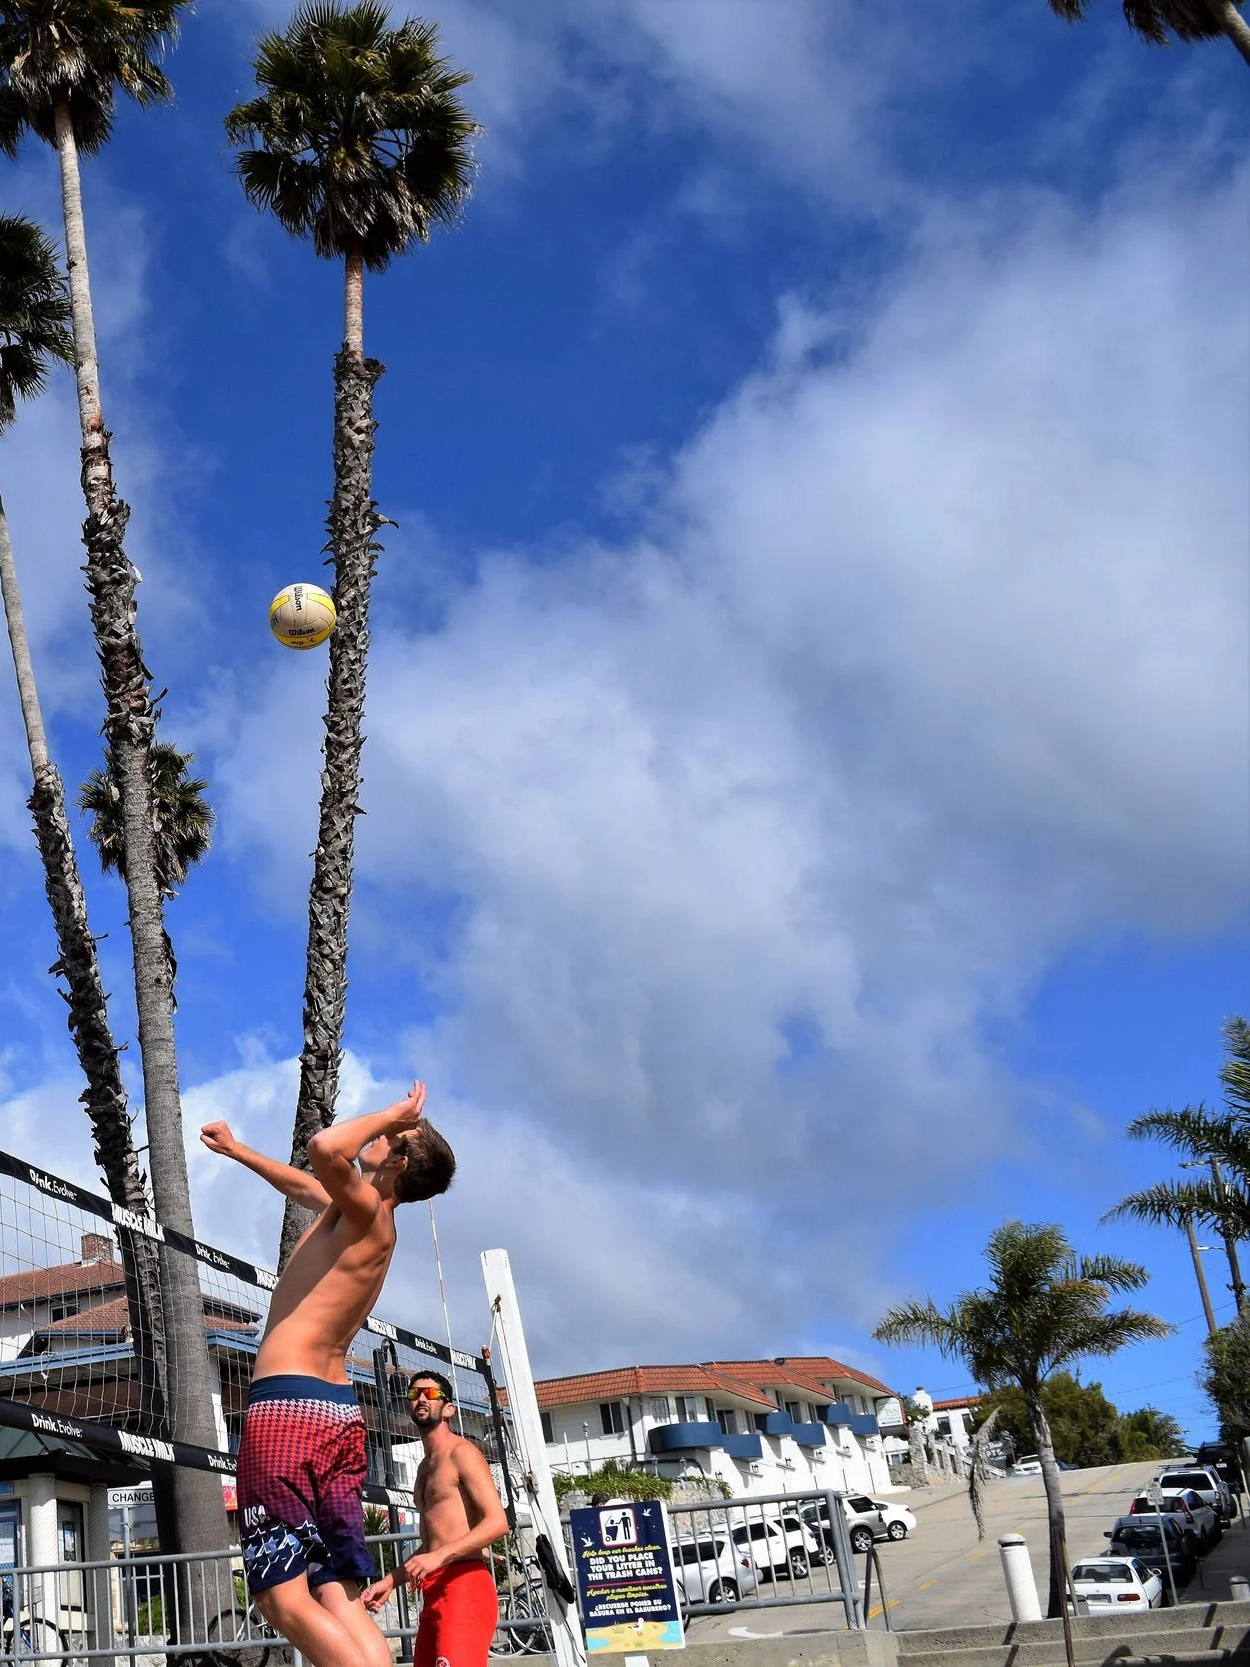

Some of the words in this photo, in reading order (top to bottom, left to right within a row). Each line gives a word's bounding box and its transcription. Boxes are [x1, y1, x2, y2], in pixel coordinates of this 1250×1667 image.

[294, 585, 303, 611] Wilson
[288, 628, 315, 636] Wilson
[111, 1202, 144, 1234] MUSCLE
[143, 1215, 165, 1241] MILK
[31, 1413, 58, 1432] Drink.
[117, 1430, 154, 1457] MUSCLE
[153, 1437, 175, 1462] MILK
[207, 1454, 228, 1470] Drink.
[112, 1490, 154, 1502] CHANGE
[244, 1505, 267, 1528] USA
[590, 1557, 605, 1565] DID
[607, 1554, 625, 1562] YOU
[628, 1552, 654, 1560] PLACE
[587, 1573, 603, 1581] THE
[605, 1570, 633, 1579] TRASH
[635, 1567, 663, 1576] CANS?
[590, 1564, 614, 1573] YOUR
[616, 1561, 643, 1570] LITTER
[589, 1609, 615, 1617] BASURA
[635, 1604, 671, 1613] BASURERO?
